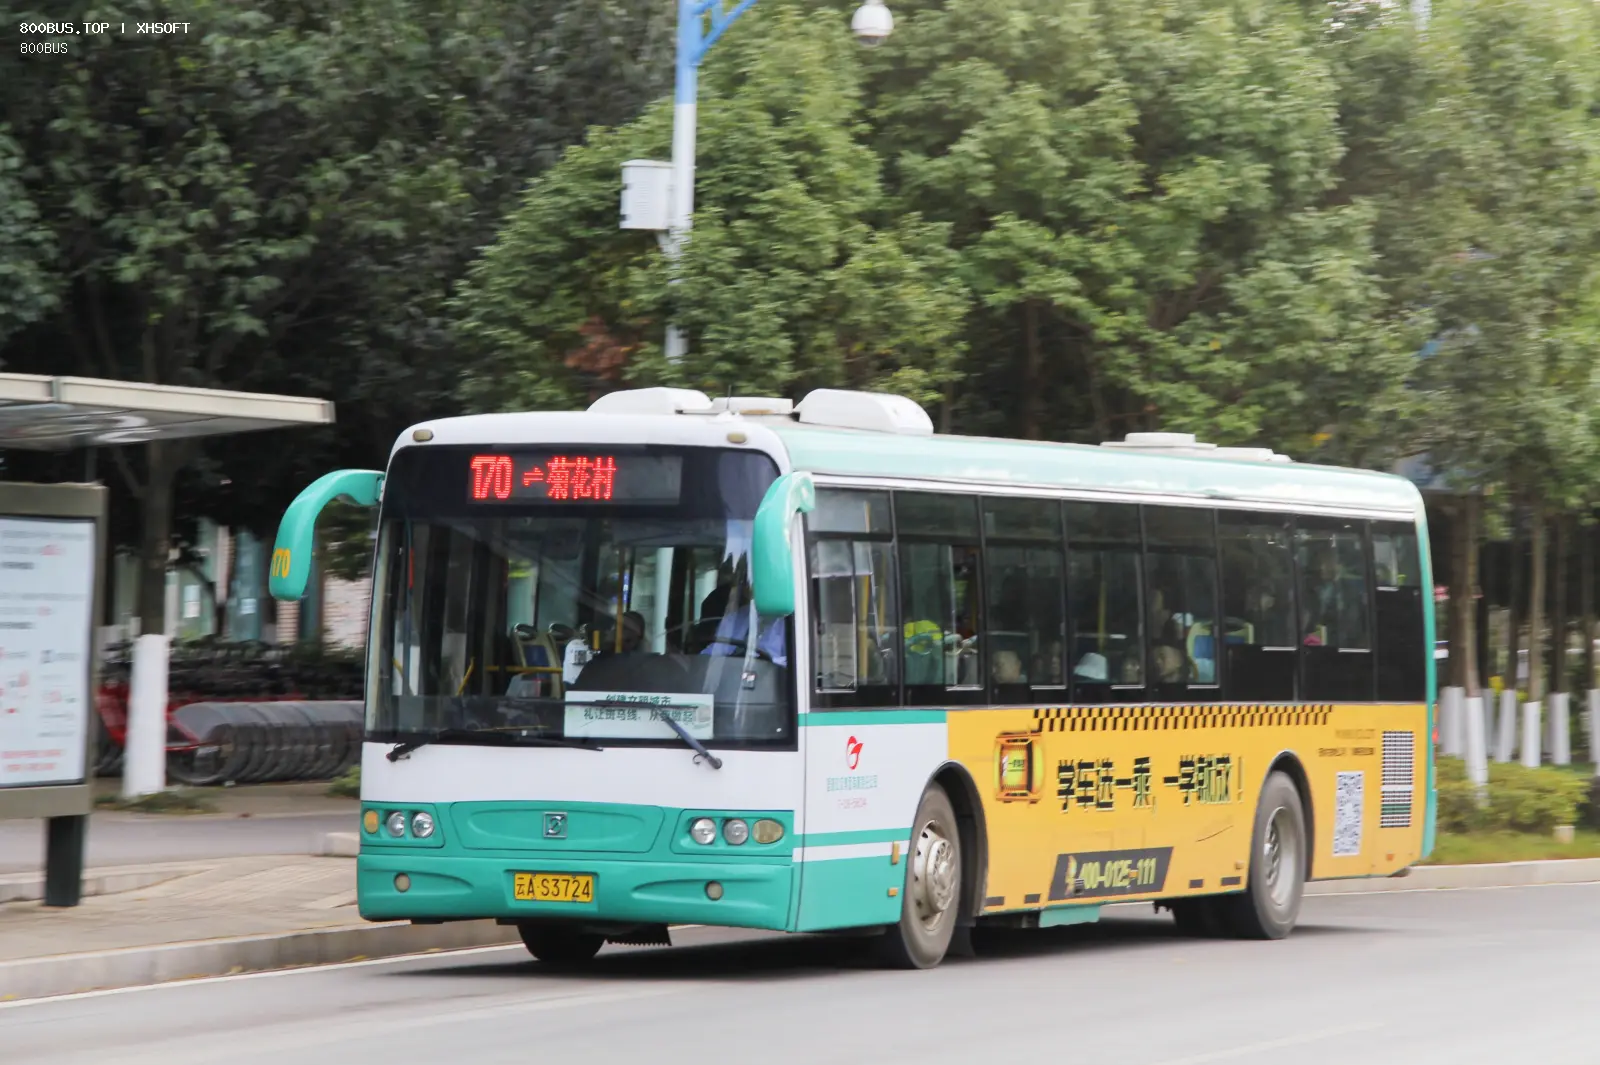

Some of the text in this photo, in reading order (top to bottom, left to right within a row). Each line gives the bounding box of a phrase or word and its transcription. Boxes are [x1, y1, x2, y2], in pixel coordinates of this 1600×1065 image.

[471, 455, 617, 500] 170 菊花村
[271, 547, 291, 578] 170
